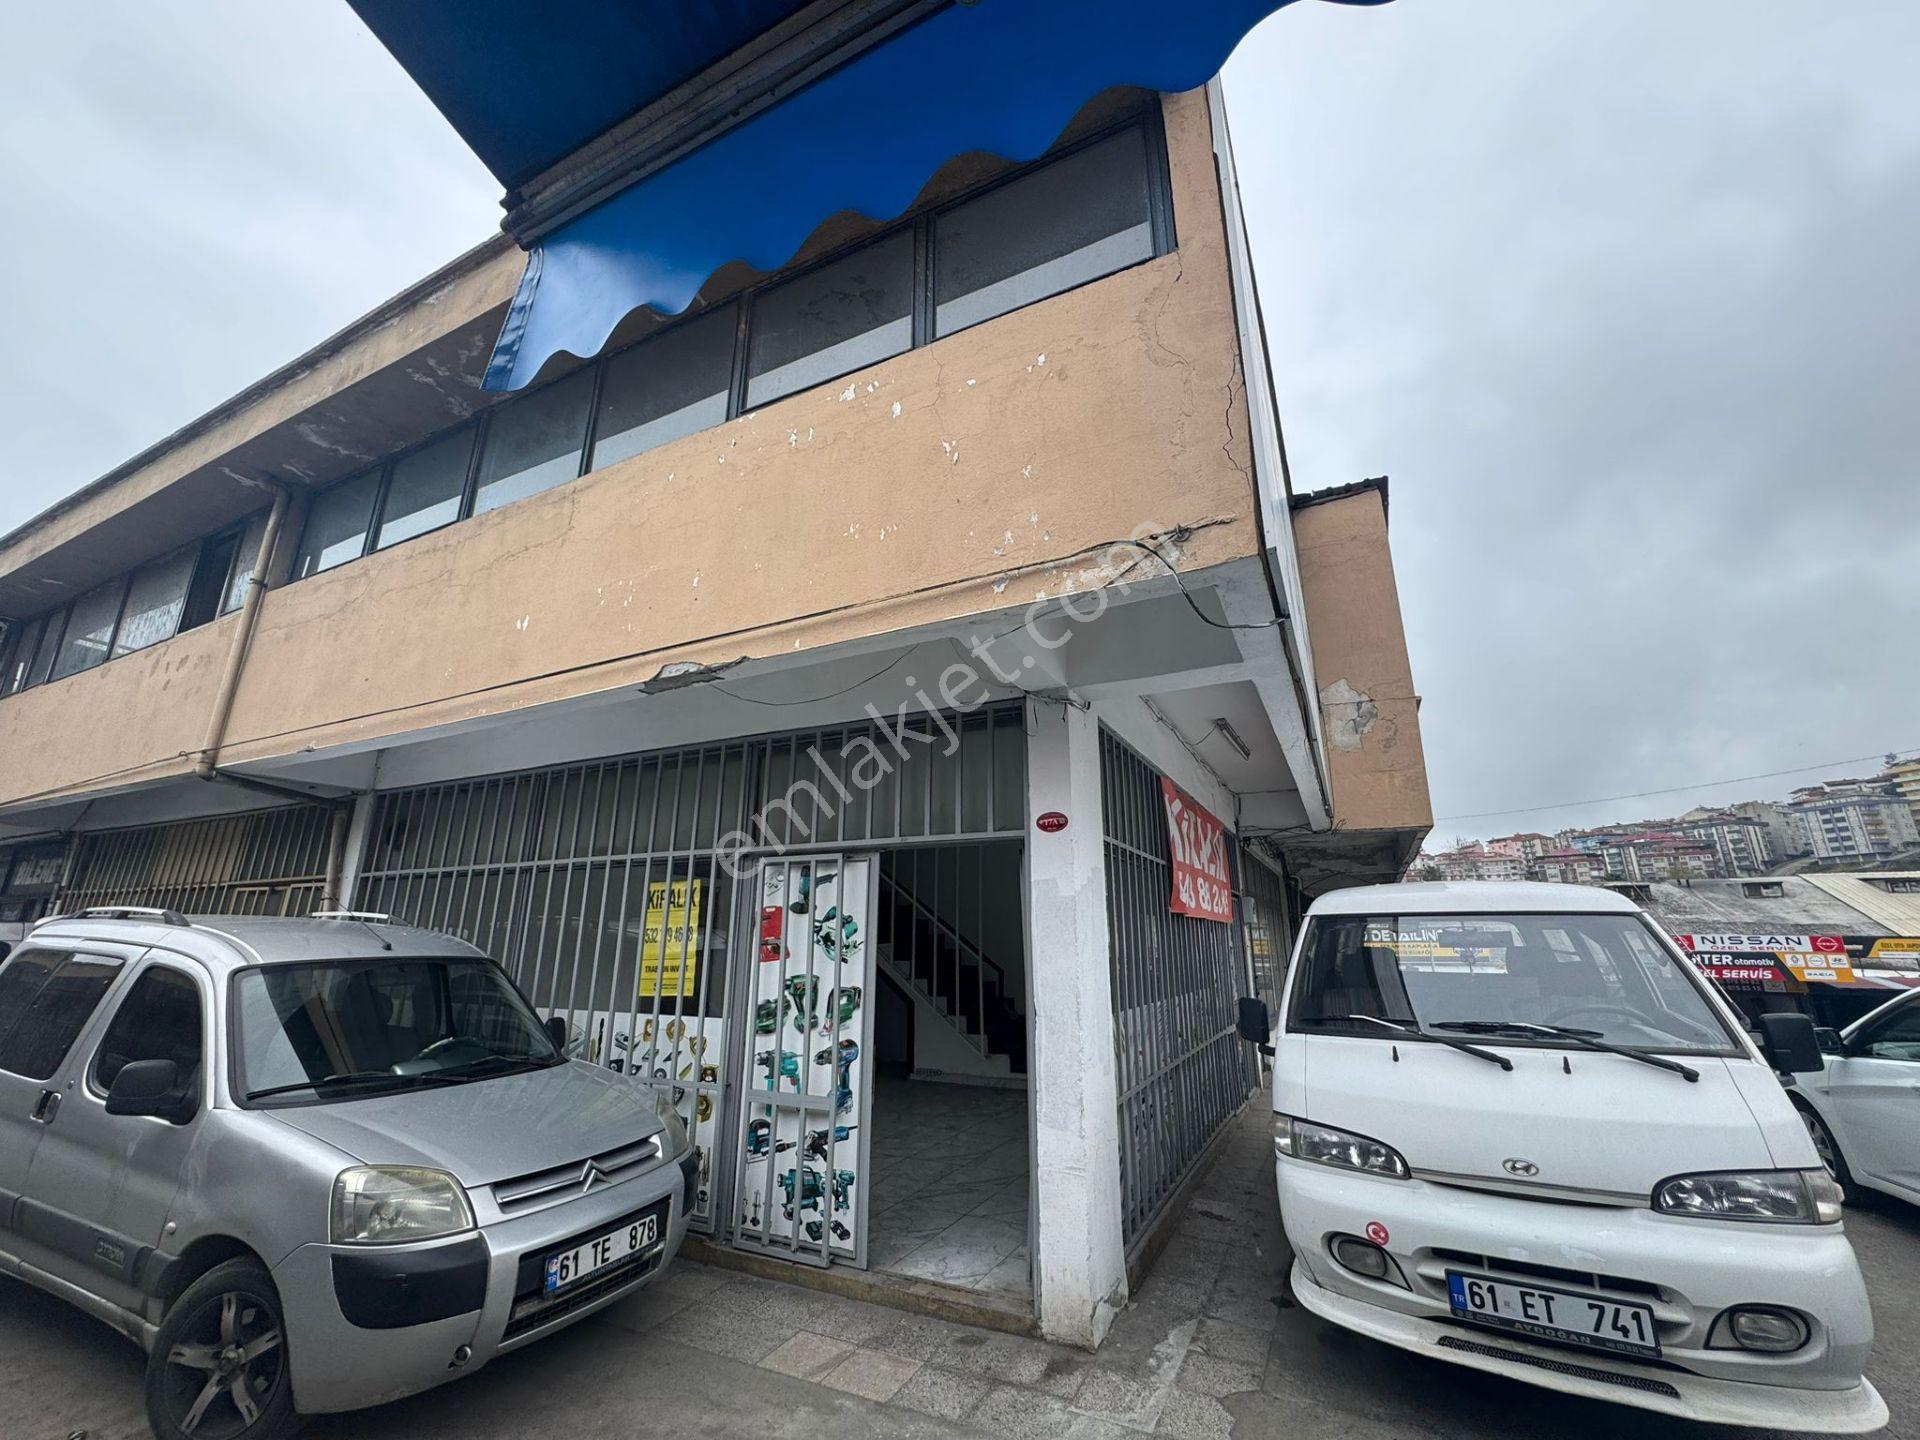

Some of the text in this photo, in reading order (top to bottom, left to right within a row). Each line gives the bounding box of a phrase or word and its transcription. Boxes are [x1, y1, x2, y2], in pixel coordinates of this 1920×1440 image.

[648, 886, 698, 910] KiALK
[1701, 936, 1803, 946] NISSAN
[1722, 968, 1773, 979] SERVİS
[560, 1218, 655, 1281] 61 TE 878
[1454, 1292, 1465, 1304] TR
[1468, 1281, 1646, 1342] 61 ET 741
[1514, 1322, 1591, 1344] AYDOĞAN
